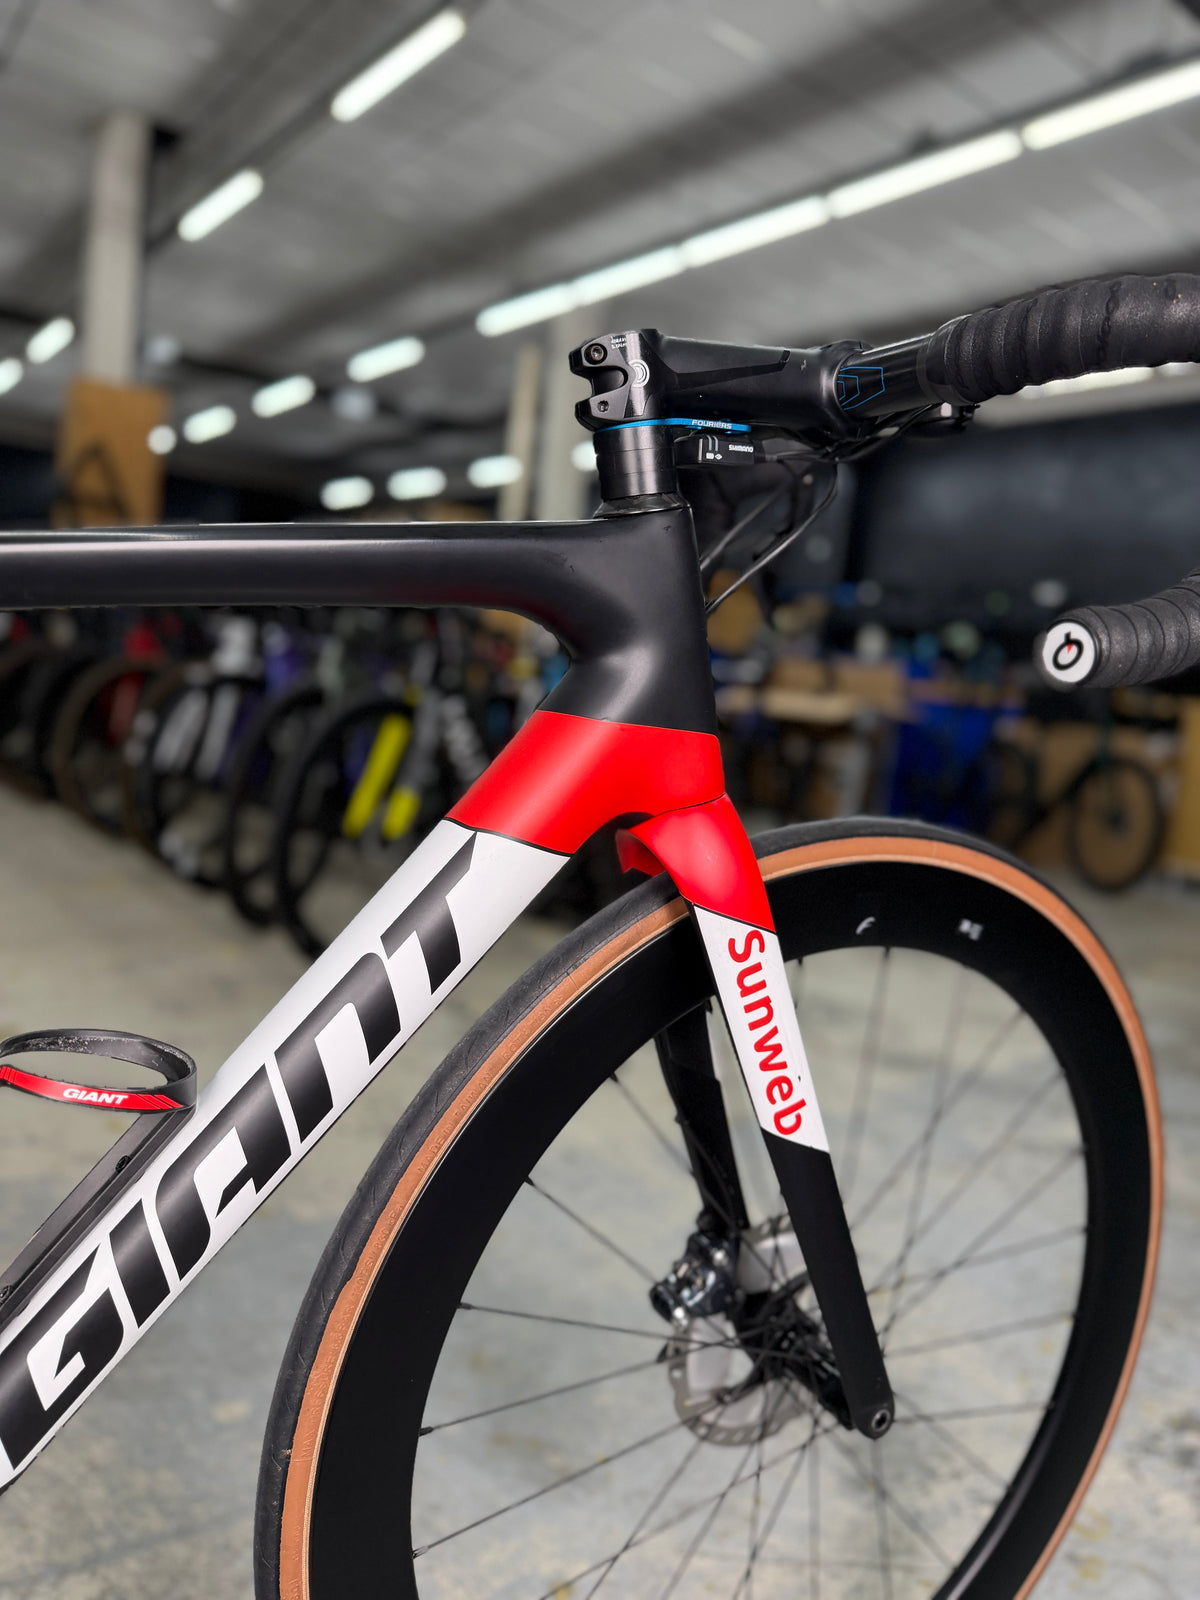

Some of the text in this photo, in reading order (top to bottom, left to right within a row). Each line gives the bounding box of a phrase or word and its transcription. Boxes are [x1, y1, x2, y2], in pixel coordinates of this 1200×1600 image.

[691, 419, 732, 430] FOURIERS
[728, 443, 754, 453] SHIMANO
[728, 929, 807, 1136] Sunweb
[62, 1087, 129, 1105] GIANT
